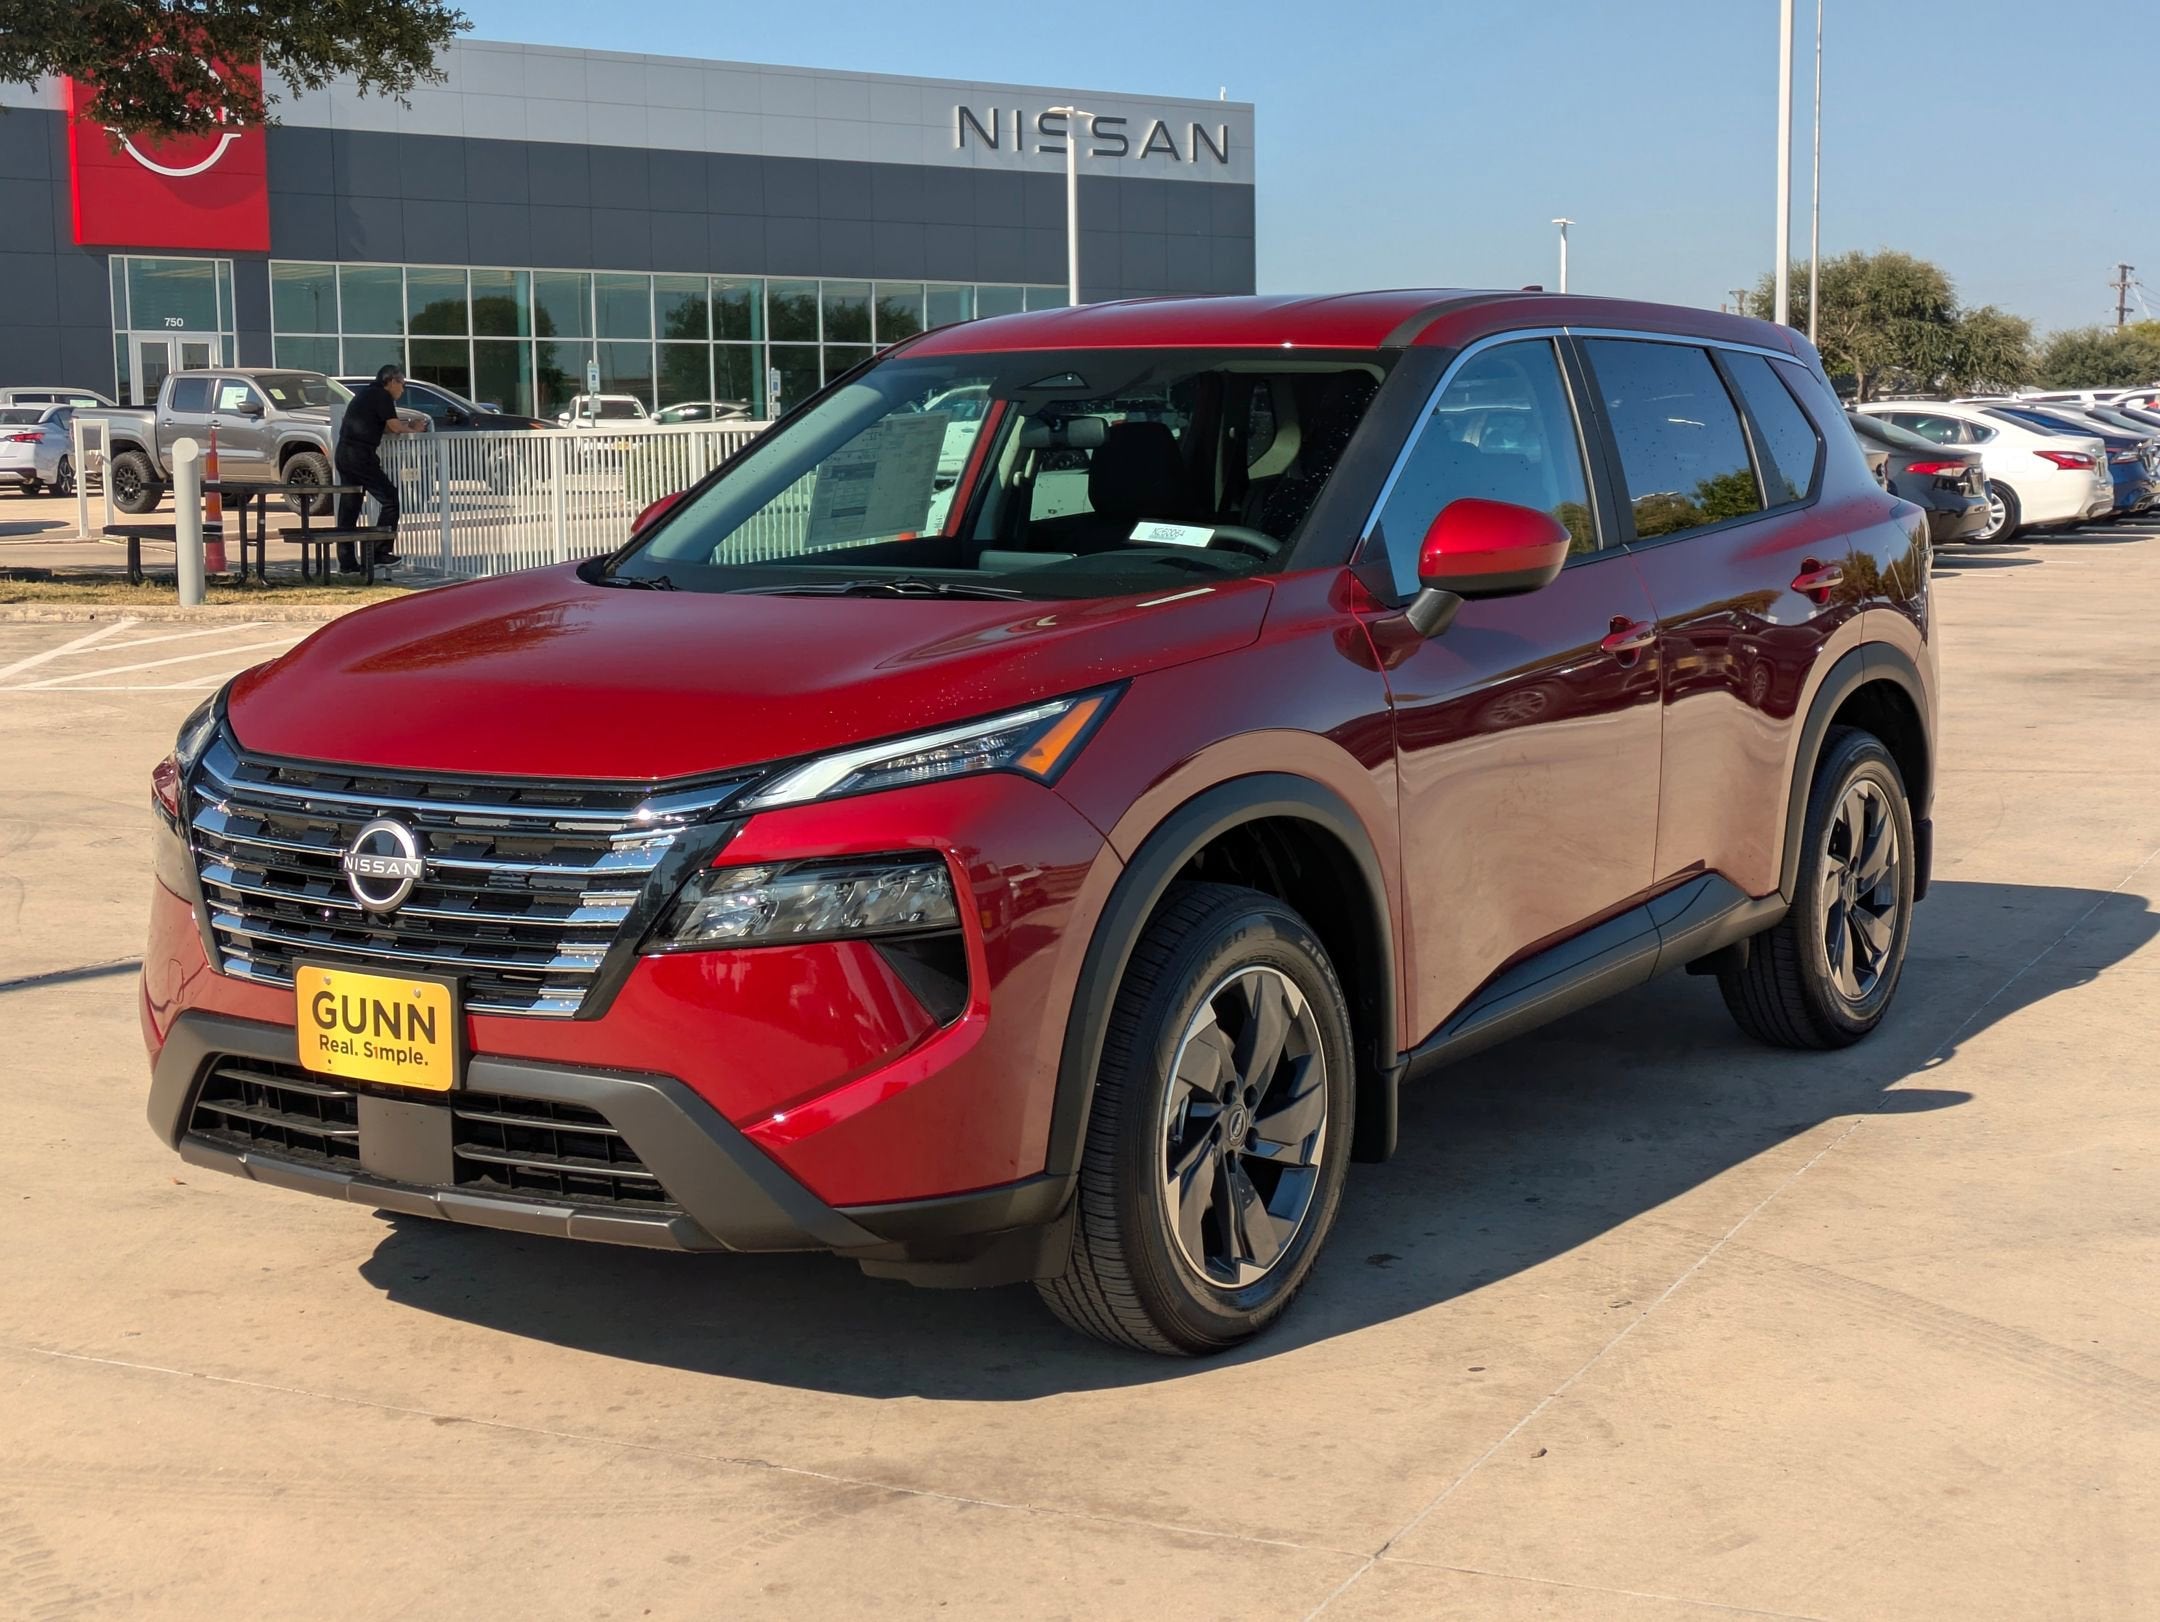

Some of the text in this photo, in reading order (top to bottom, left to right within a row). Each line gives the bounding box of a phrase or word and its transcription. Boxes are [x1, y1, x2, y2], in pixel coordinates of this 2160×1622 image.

[956, 105, 1229, 165] NISSAN
[164, 317, 184, 327] 750
[344, 855, 419, 876] NISSAN
[312, 990, 436, 1045] GUNN
[319, 1034, 358, 1056] Real.
